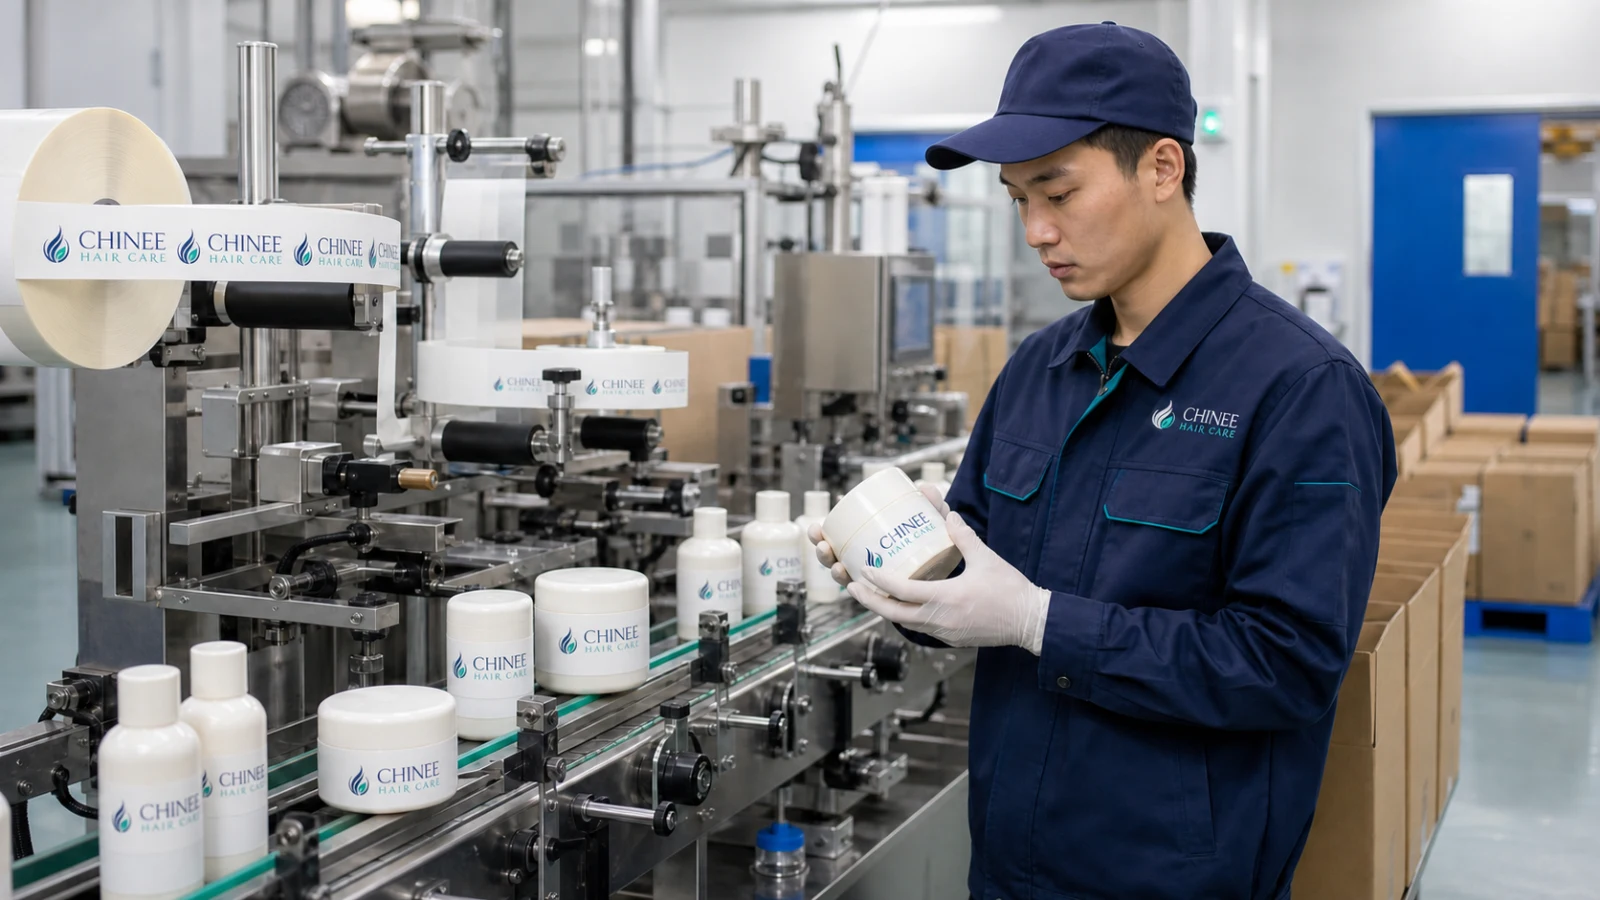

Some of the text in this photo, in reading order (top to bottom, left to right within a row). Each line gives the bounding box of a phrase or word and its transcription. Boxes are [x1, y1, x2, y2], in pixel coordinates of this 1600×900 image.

[79, 230, 166, 250] CHINEE
[208, 233, 282, 253] CHINEE
[318, 237, 363, 256] CHINEE
[80, 252, 166, 263] HAIR CARE
[209, 254, 282, 265] HAIR CARE
[318, 257, 343, 268] HAIR
[602, 379, 645, 389] CHINEE
[1183, 407, 1239, 429] CHINEE
[1179, 422, 1236, 438] HAIR CARE
[879, 512, 930, 549] CHINEE
[887, 522, 936, 557] HAIR CARE
[583, 625, 639, 644] CHINEE
[584, 640, 639, 653] HAIR CARE
[473, 652, 527, 671] CHINEE
[473, 669, 527, 681] HAIR CARE
[219, 764, 265, 787] CHINEE
[377, 760, 440, 784] CHINEE
[220, 787, 247, 798] HAIR
[378, 778, 440, 795] HAIR CARE
[140, 793, 200, 821] CHINEE
[141, 821, 175, 832] HAIR
